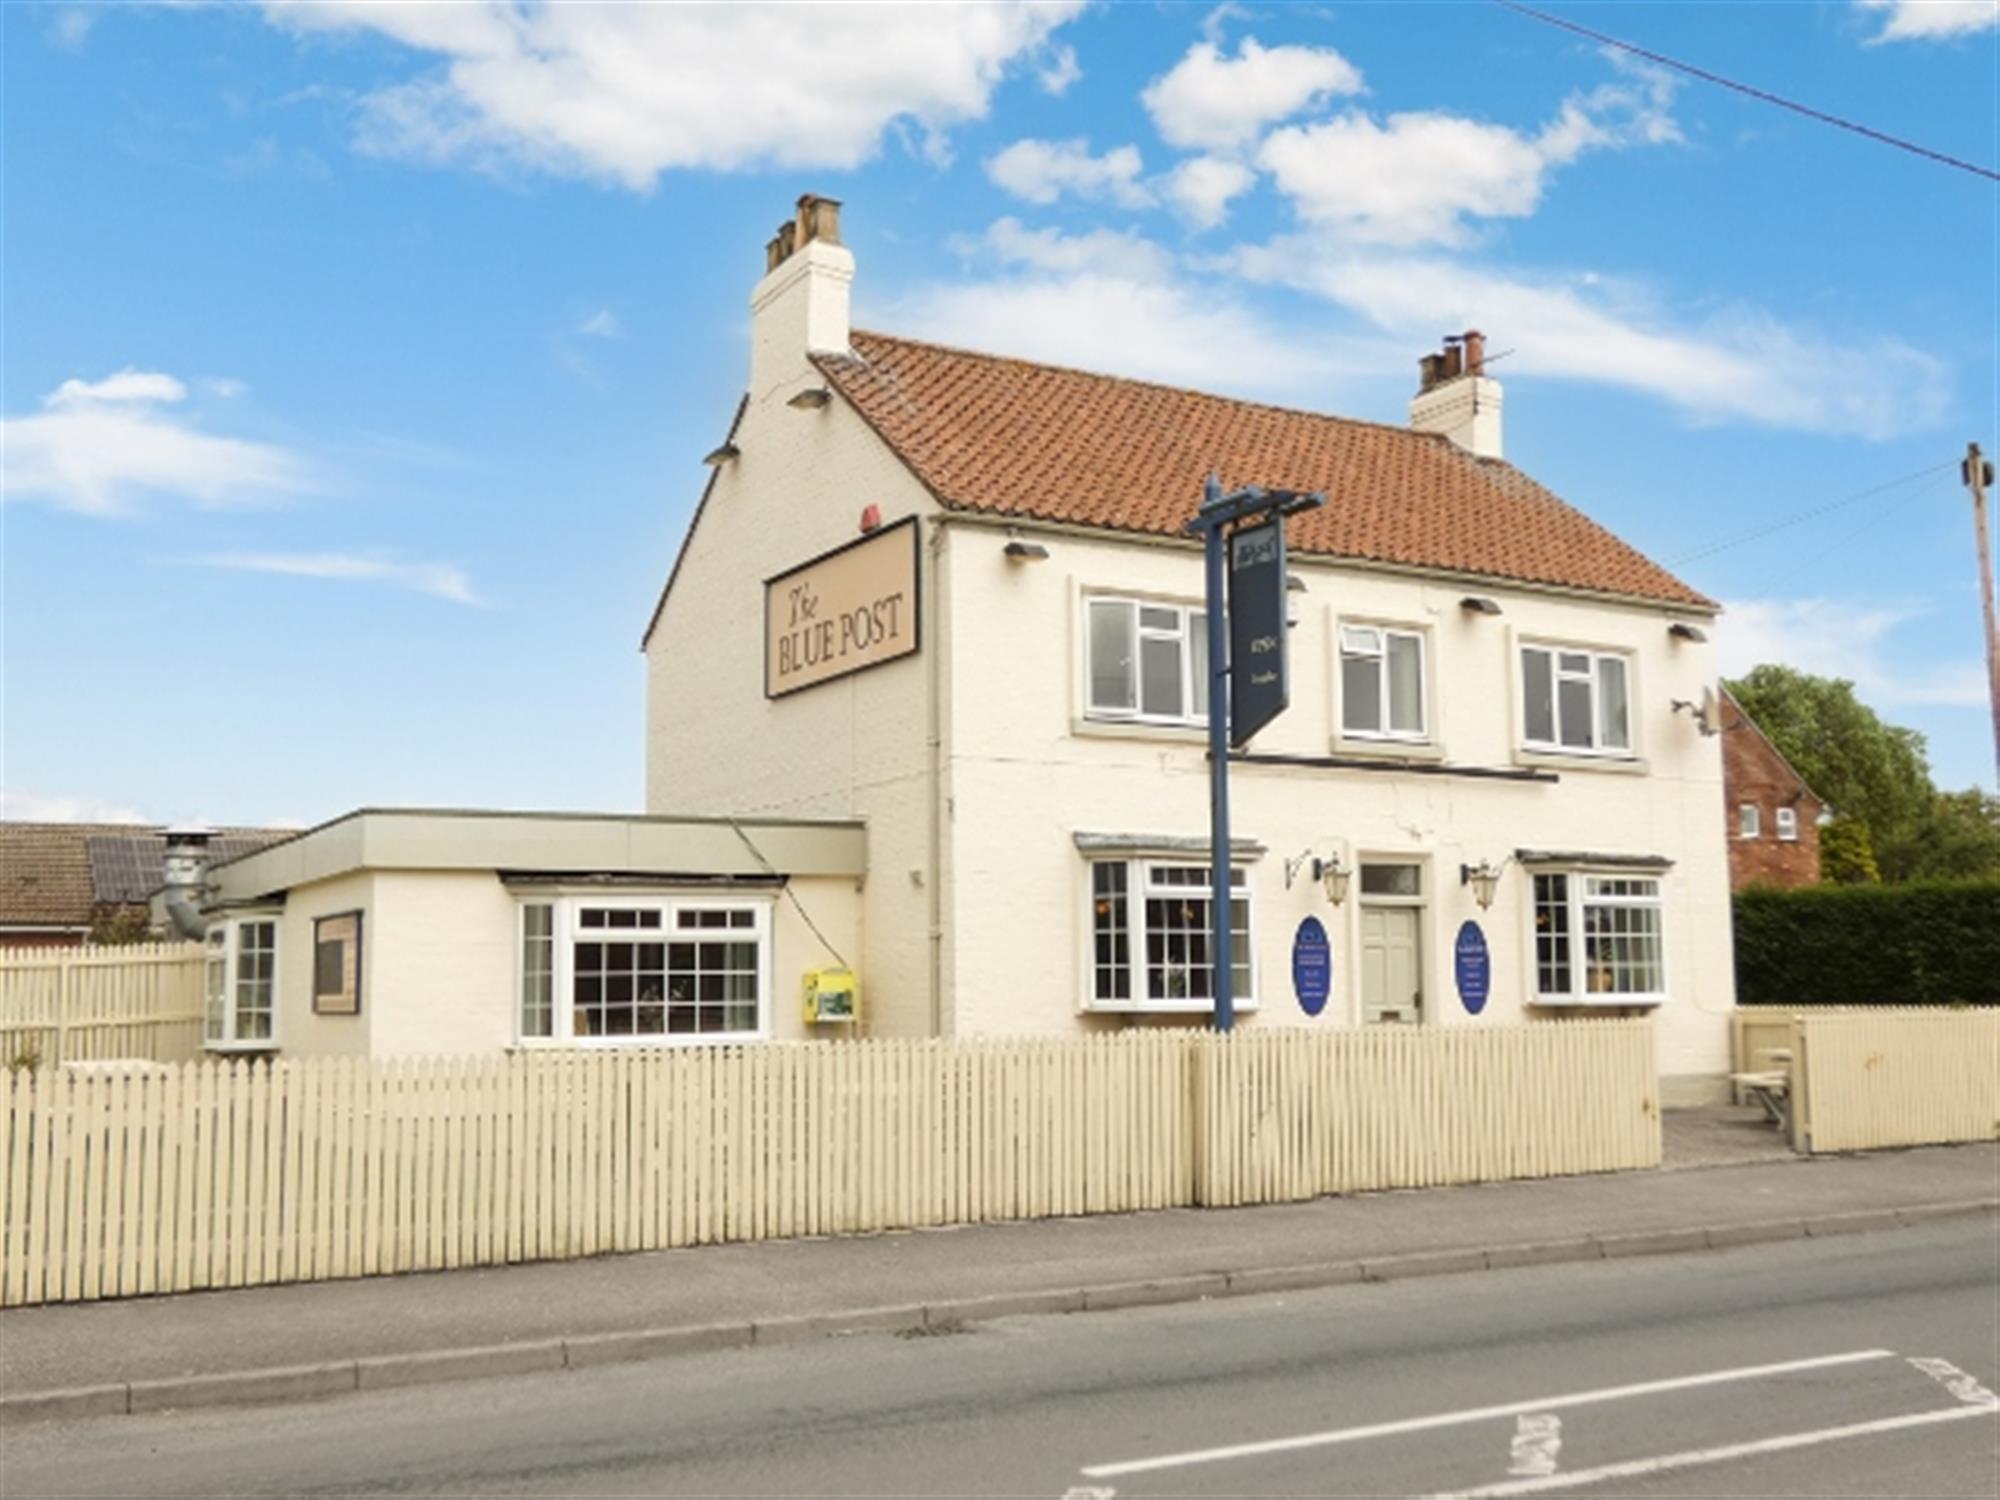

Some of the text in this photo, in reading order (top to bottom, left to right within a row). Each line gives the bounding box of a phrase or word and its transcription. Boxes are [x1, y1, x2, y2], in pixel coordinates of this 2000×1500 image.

[779, 592, 903, 676] BLUE POST
[788, 582, 819, 628] The
